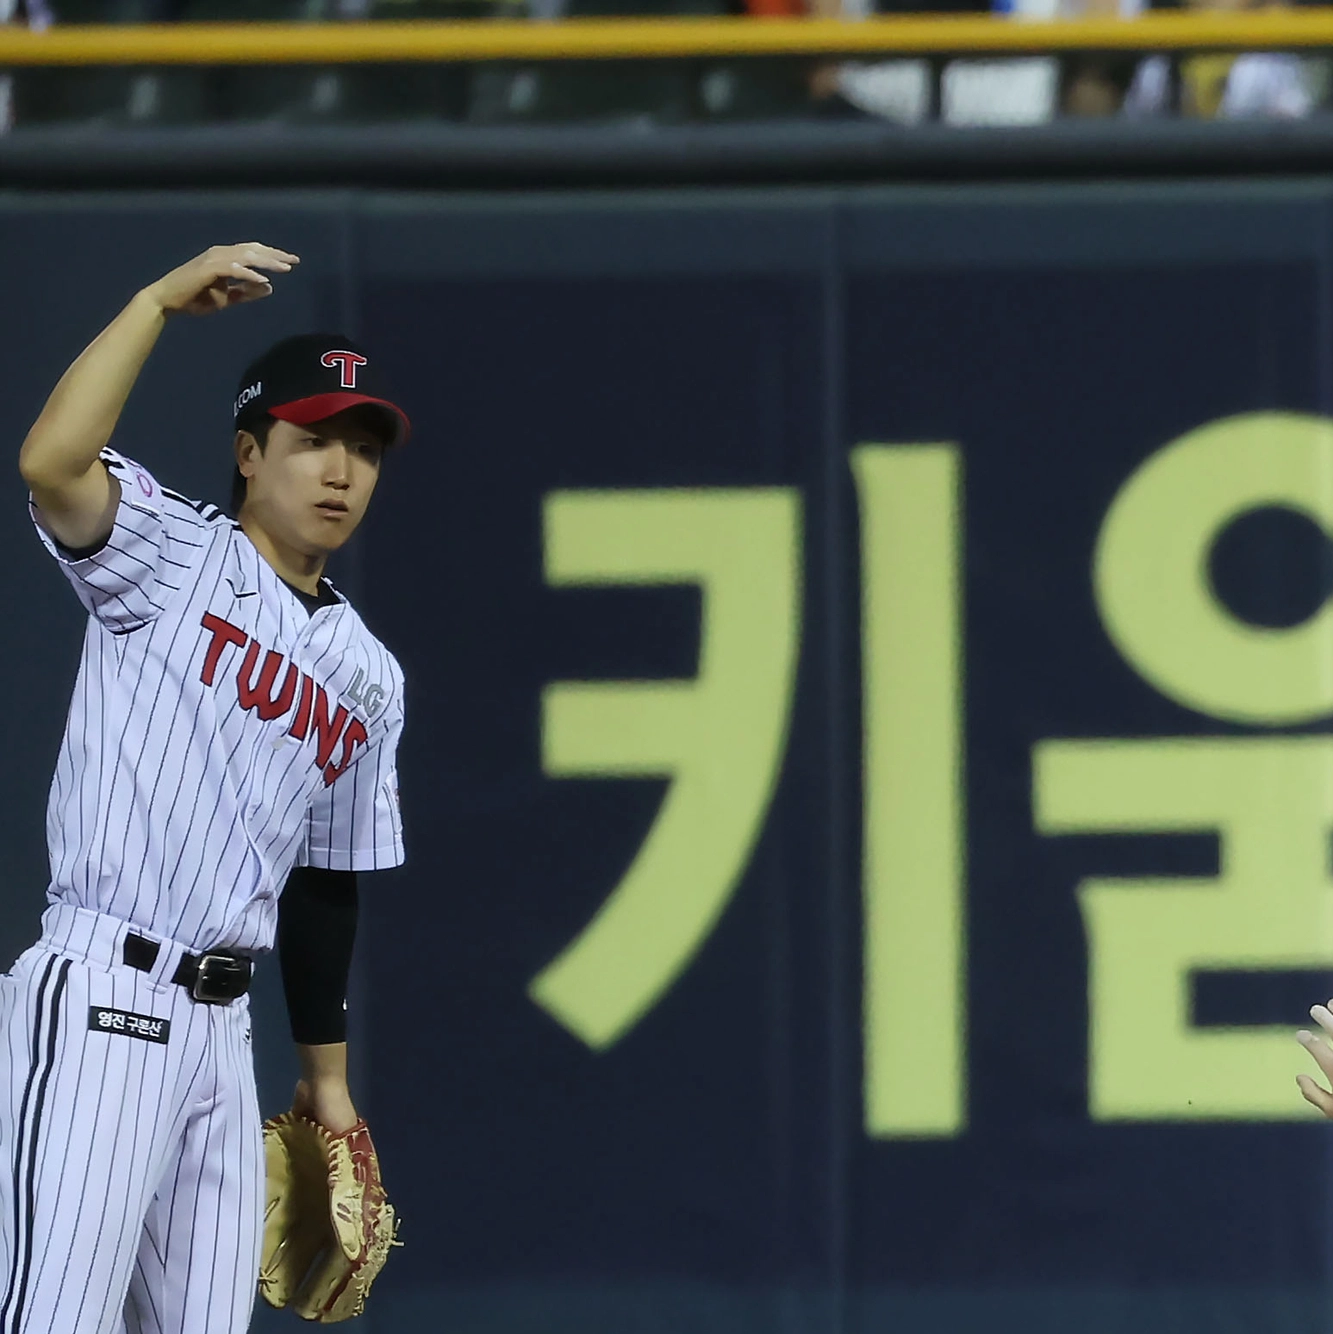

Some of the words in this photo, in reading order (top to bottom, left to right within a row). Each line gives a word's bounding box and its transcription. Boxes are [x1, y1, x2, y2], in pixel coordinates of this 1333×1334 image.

[321, 350, 367, 388] T
[200, 611, 369, 788] TWINS
[349, 668, 384, 718] LG
[98, 1011, 125, 1029] 영진
[127, 1017, 163, 1037] 구론산
